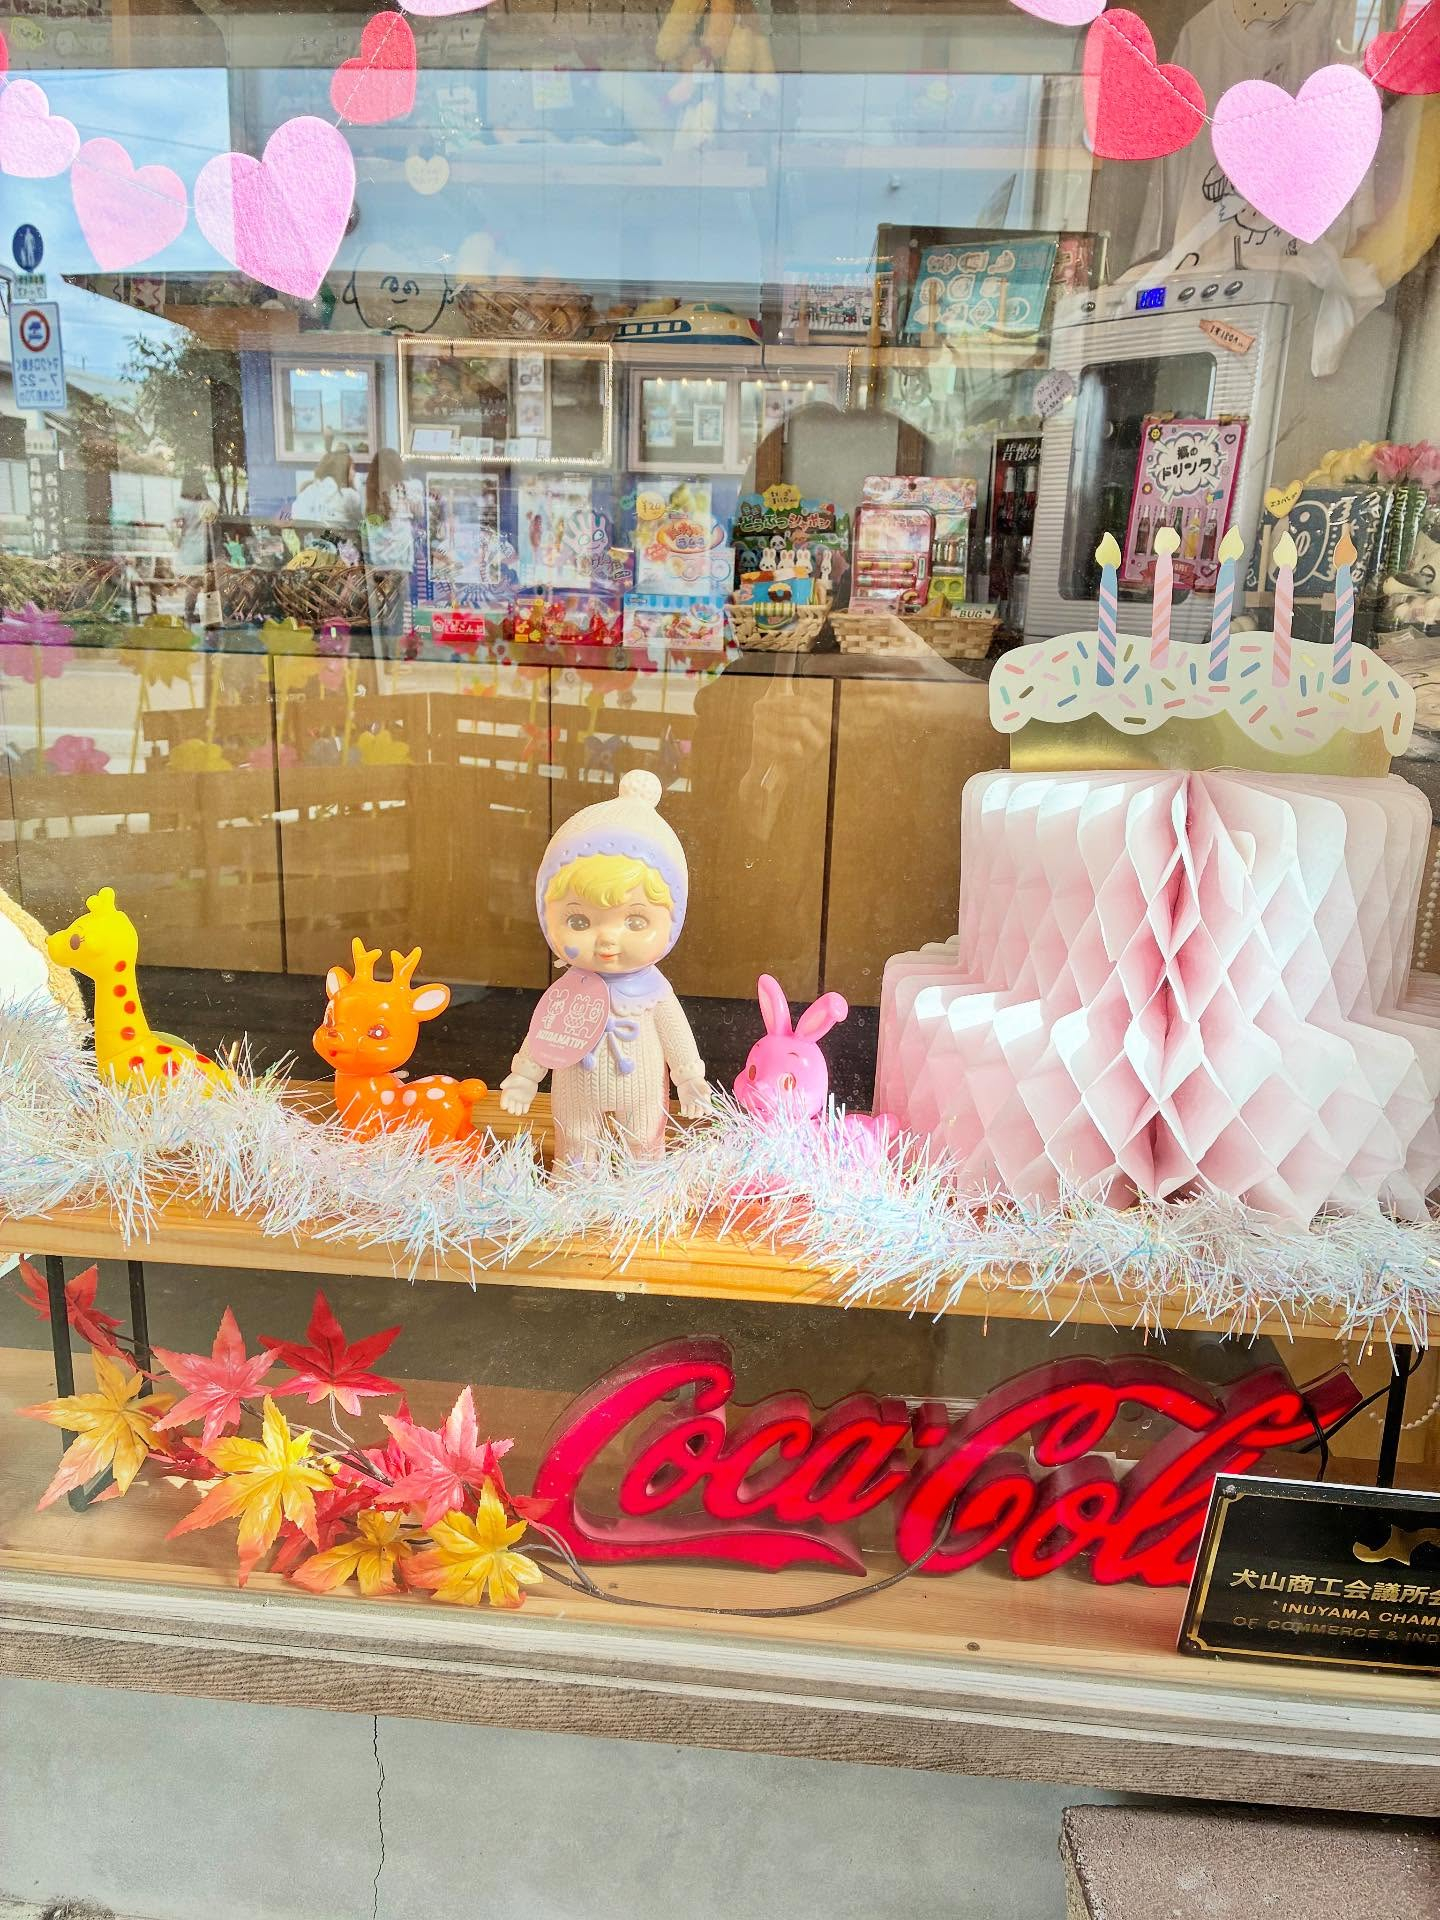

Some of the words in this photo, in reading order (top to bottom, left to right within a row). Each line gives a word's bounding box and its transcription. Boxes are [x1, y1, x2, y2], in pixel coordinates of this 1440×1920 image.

[1162, 458, 1212, 481] ドリンク
[740, 512, 832, 533] どうぶつシャボン
[959, 608, 983, 619] BUG
[1281, 1602, 1371, 1621] INUYAMA
[1232, 1616, 1259, 1630] OF
[1266, 1619, 1381, 1640] COMMERCE
[1385, 1631, 1399, 1641] &
